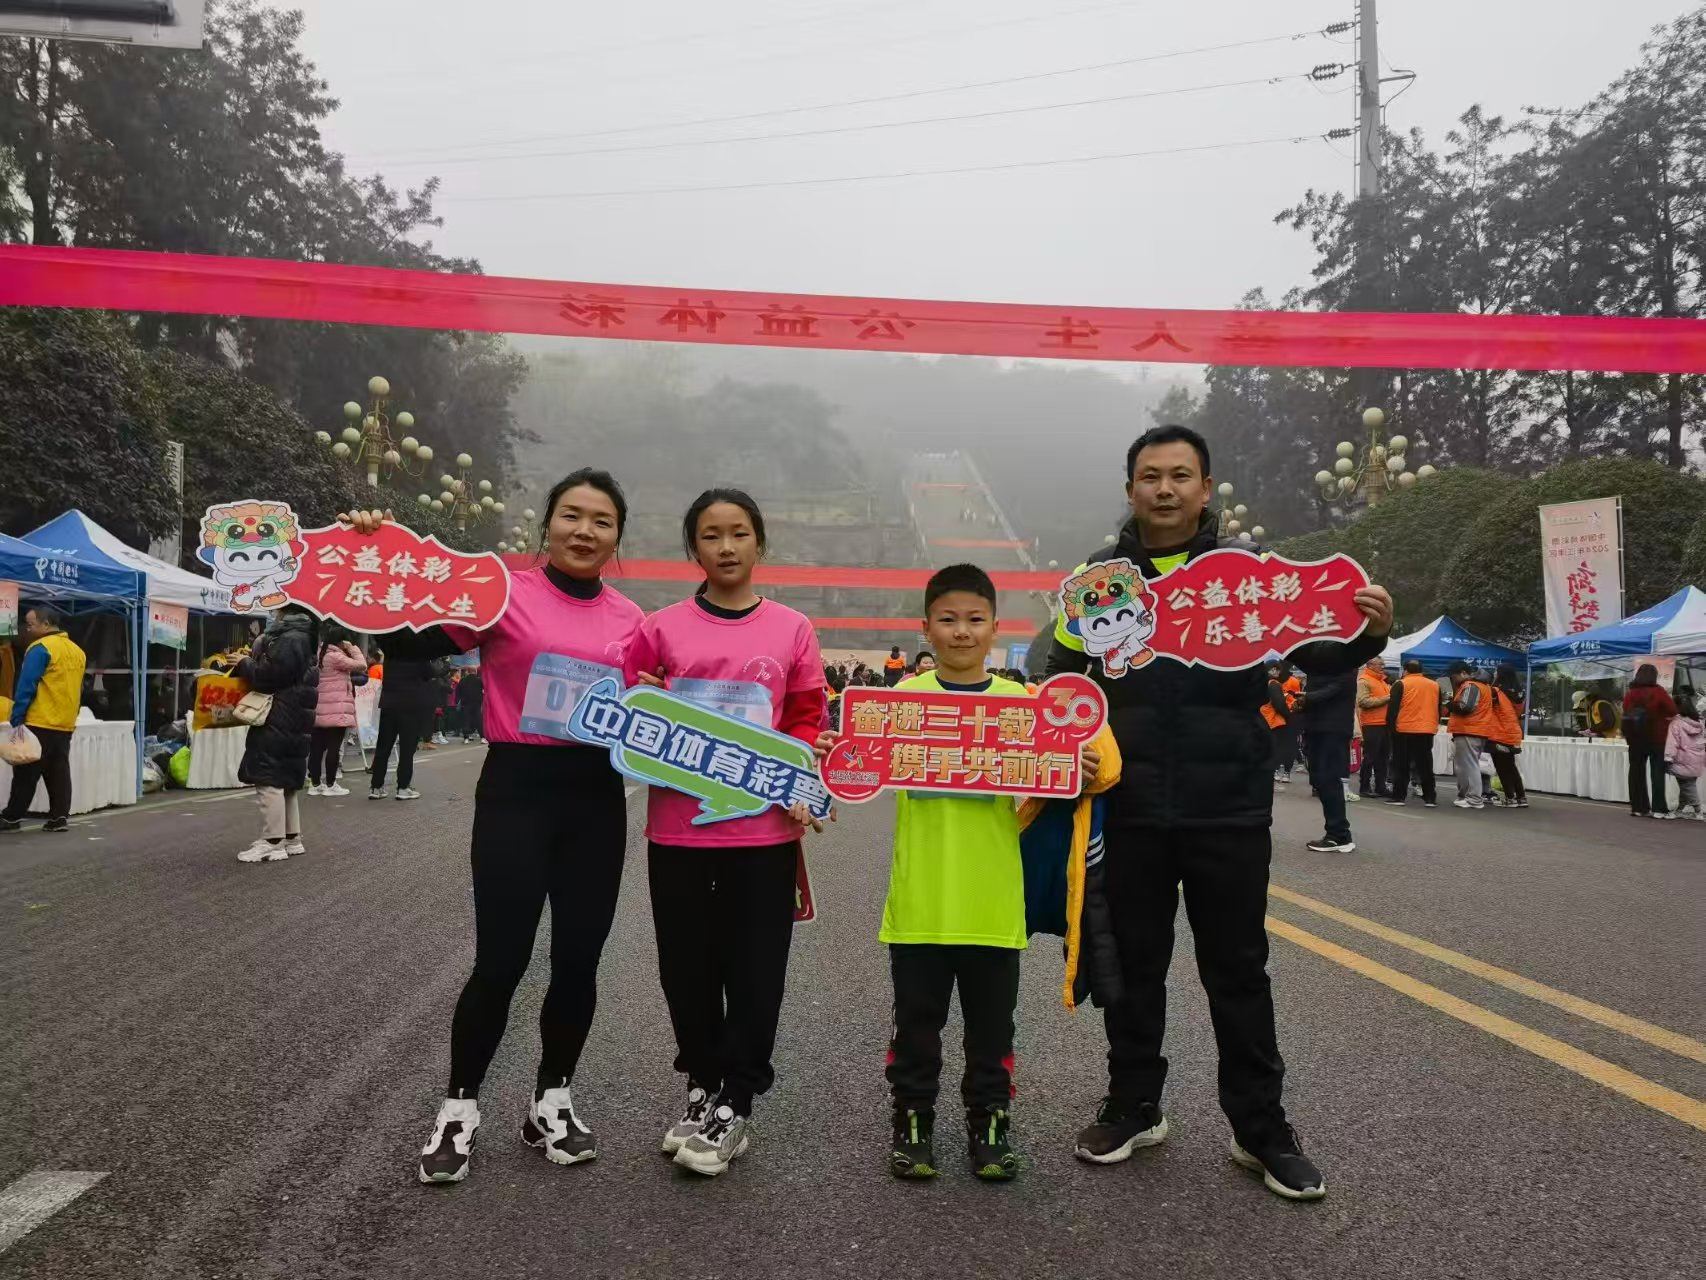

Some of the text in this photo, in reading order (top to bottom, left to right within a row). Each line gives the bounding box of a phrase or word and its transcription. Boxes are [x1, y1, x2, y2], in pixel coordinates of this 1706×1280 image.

[316, 543, 453, 584] 公益体彩
[344, 580, 478, 619] 乐善人生
[1166, 570, 1303, 611] 公益体彩
[1204, 602, 1343, 646] 乐善人生
[850, 699, 1037, 746] 奋进三十载
[1042, 687, 1100, 728] 30
[585, 696, 831, 818] 中国体育彩票
[889, 743, 1075, 789] 携手共前行
